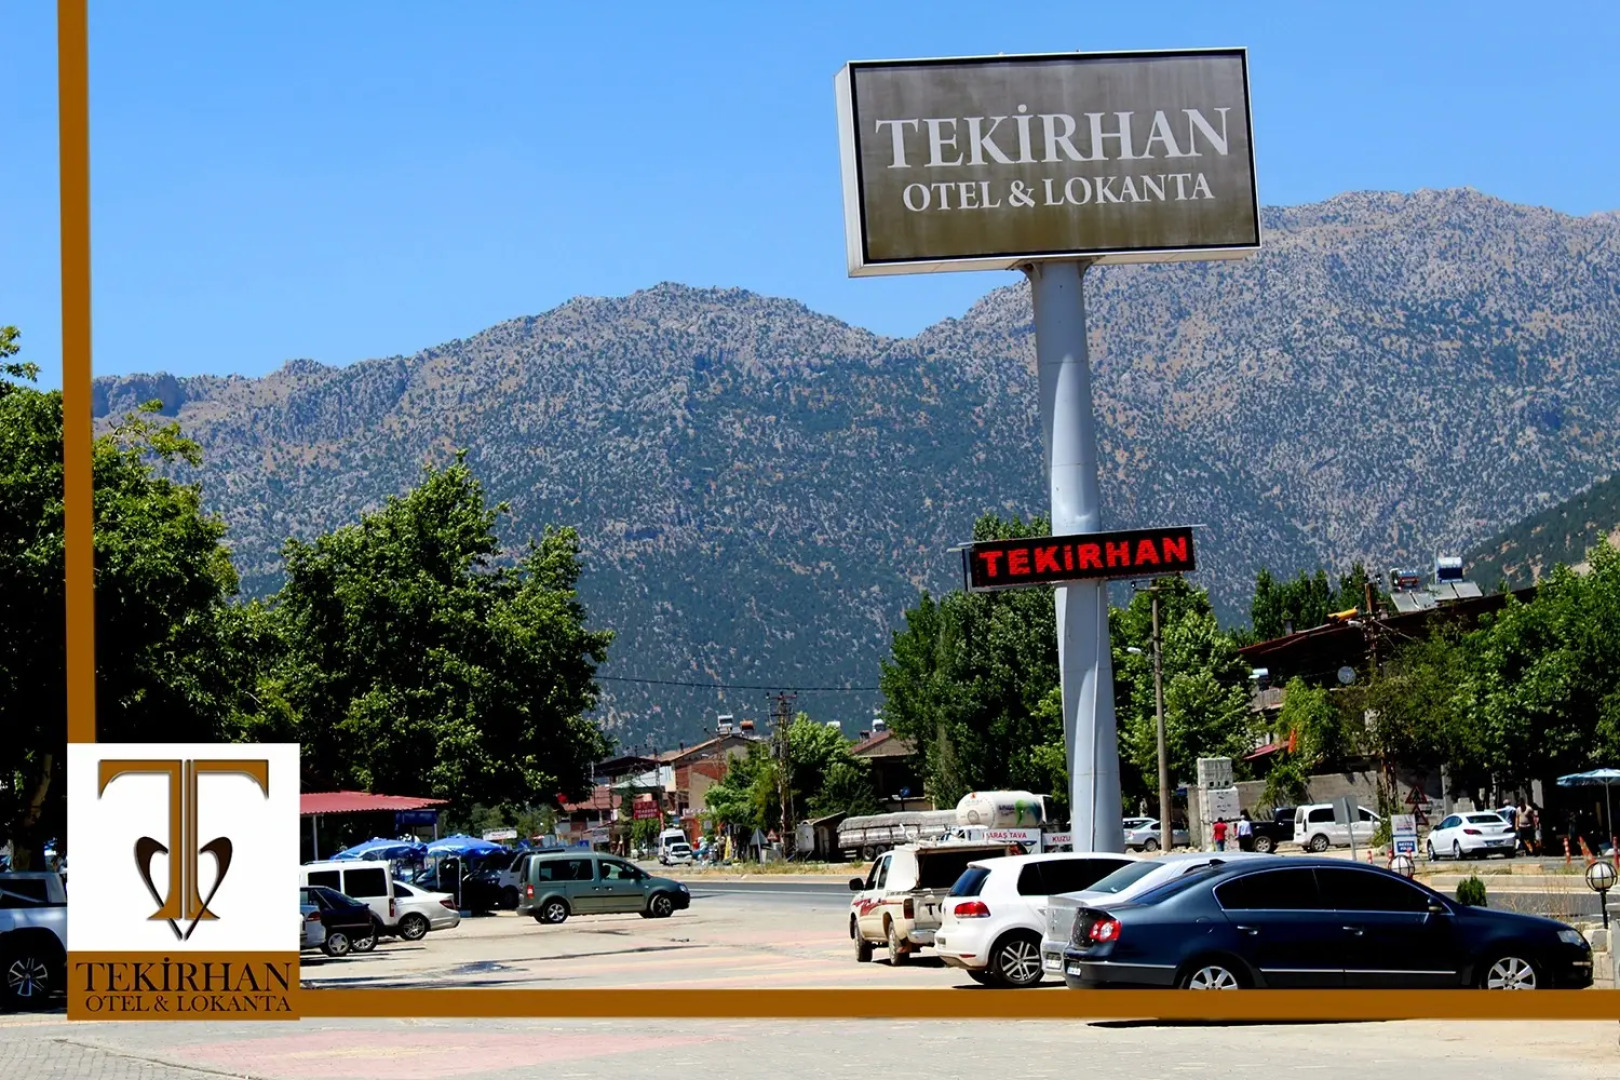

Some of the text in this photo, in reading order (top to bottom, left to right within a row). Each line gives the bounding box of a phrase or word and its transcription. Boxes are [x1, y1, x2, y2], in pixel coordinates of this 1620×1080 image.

[875, 104, 1232, 169] TEKİRHAN
[903, 172, 1215, 212] OTEL & LOKANTA
[1009, 831, 1028, 839] TAVA
